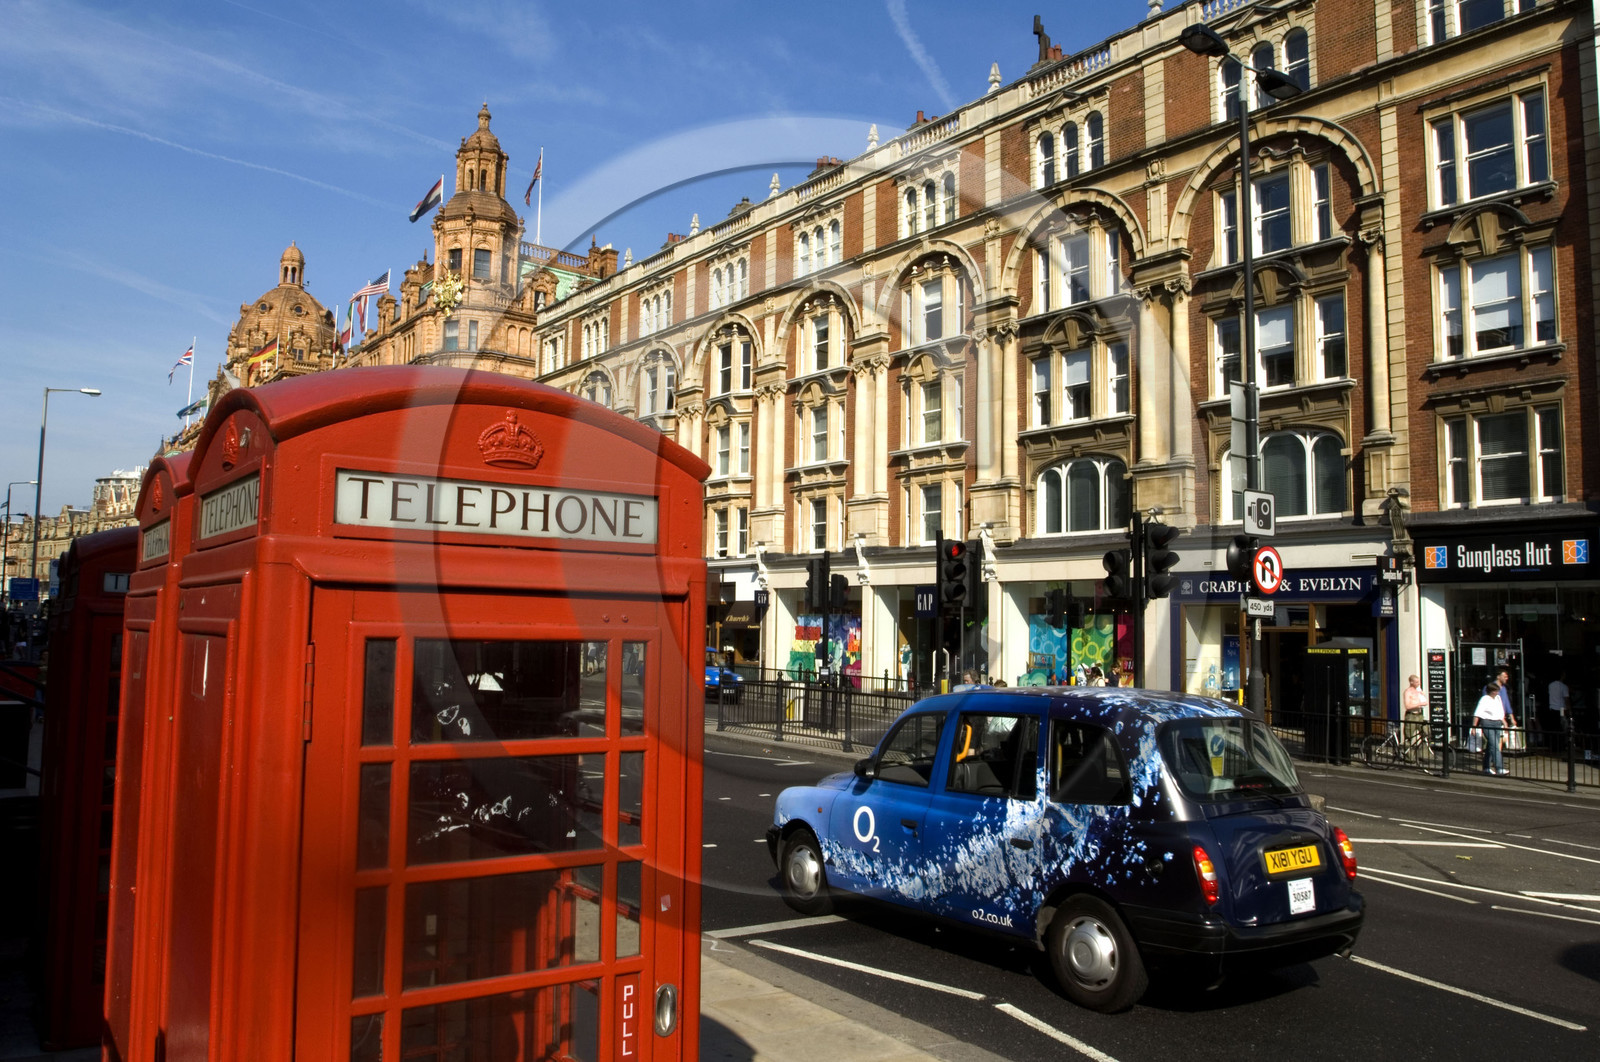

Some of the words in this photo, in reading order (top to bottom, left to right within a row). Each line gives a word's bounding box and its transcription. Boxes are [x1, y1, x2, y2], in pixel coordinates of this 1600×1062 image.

[204, 480, 260, 536] TELEPHONE
[346, 477, 645, 538] TELEPHONE
[1457, 543, 1521, 573] Sunglass
[1525, 541, 1552, 567] Hut
[1280, 578, 1292, 591] &
[1299, 577, 1362, 591] EVELYN
[917, 593, 933, 611] GAP
[1249, 602, 1262, 611] 450
[1263, 603, 1273, 613] yds
[1290, 847, 1313, 866] YGU
[1292, 890, 1312, 903] 30587
[972, 908, 1014, 928] o2.co.uk
[622, 984, 634, 1057] PULL
